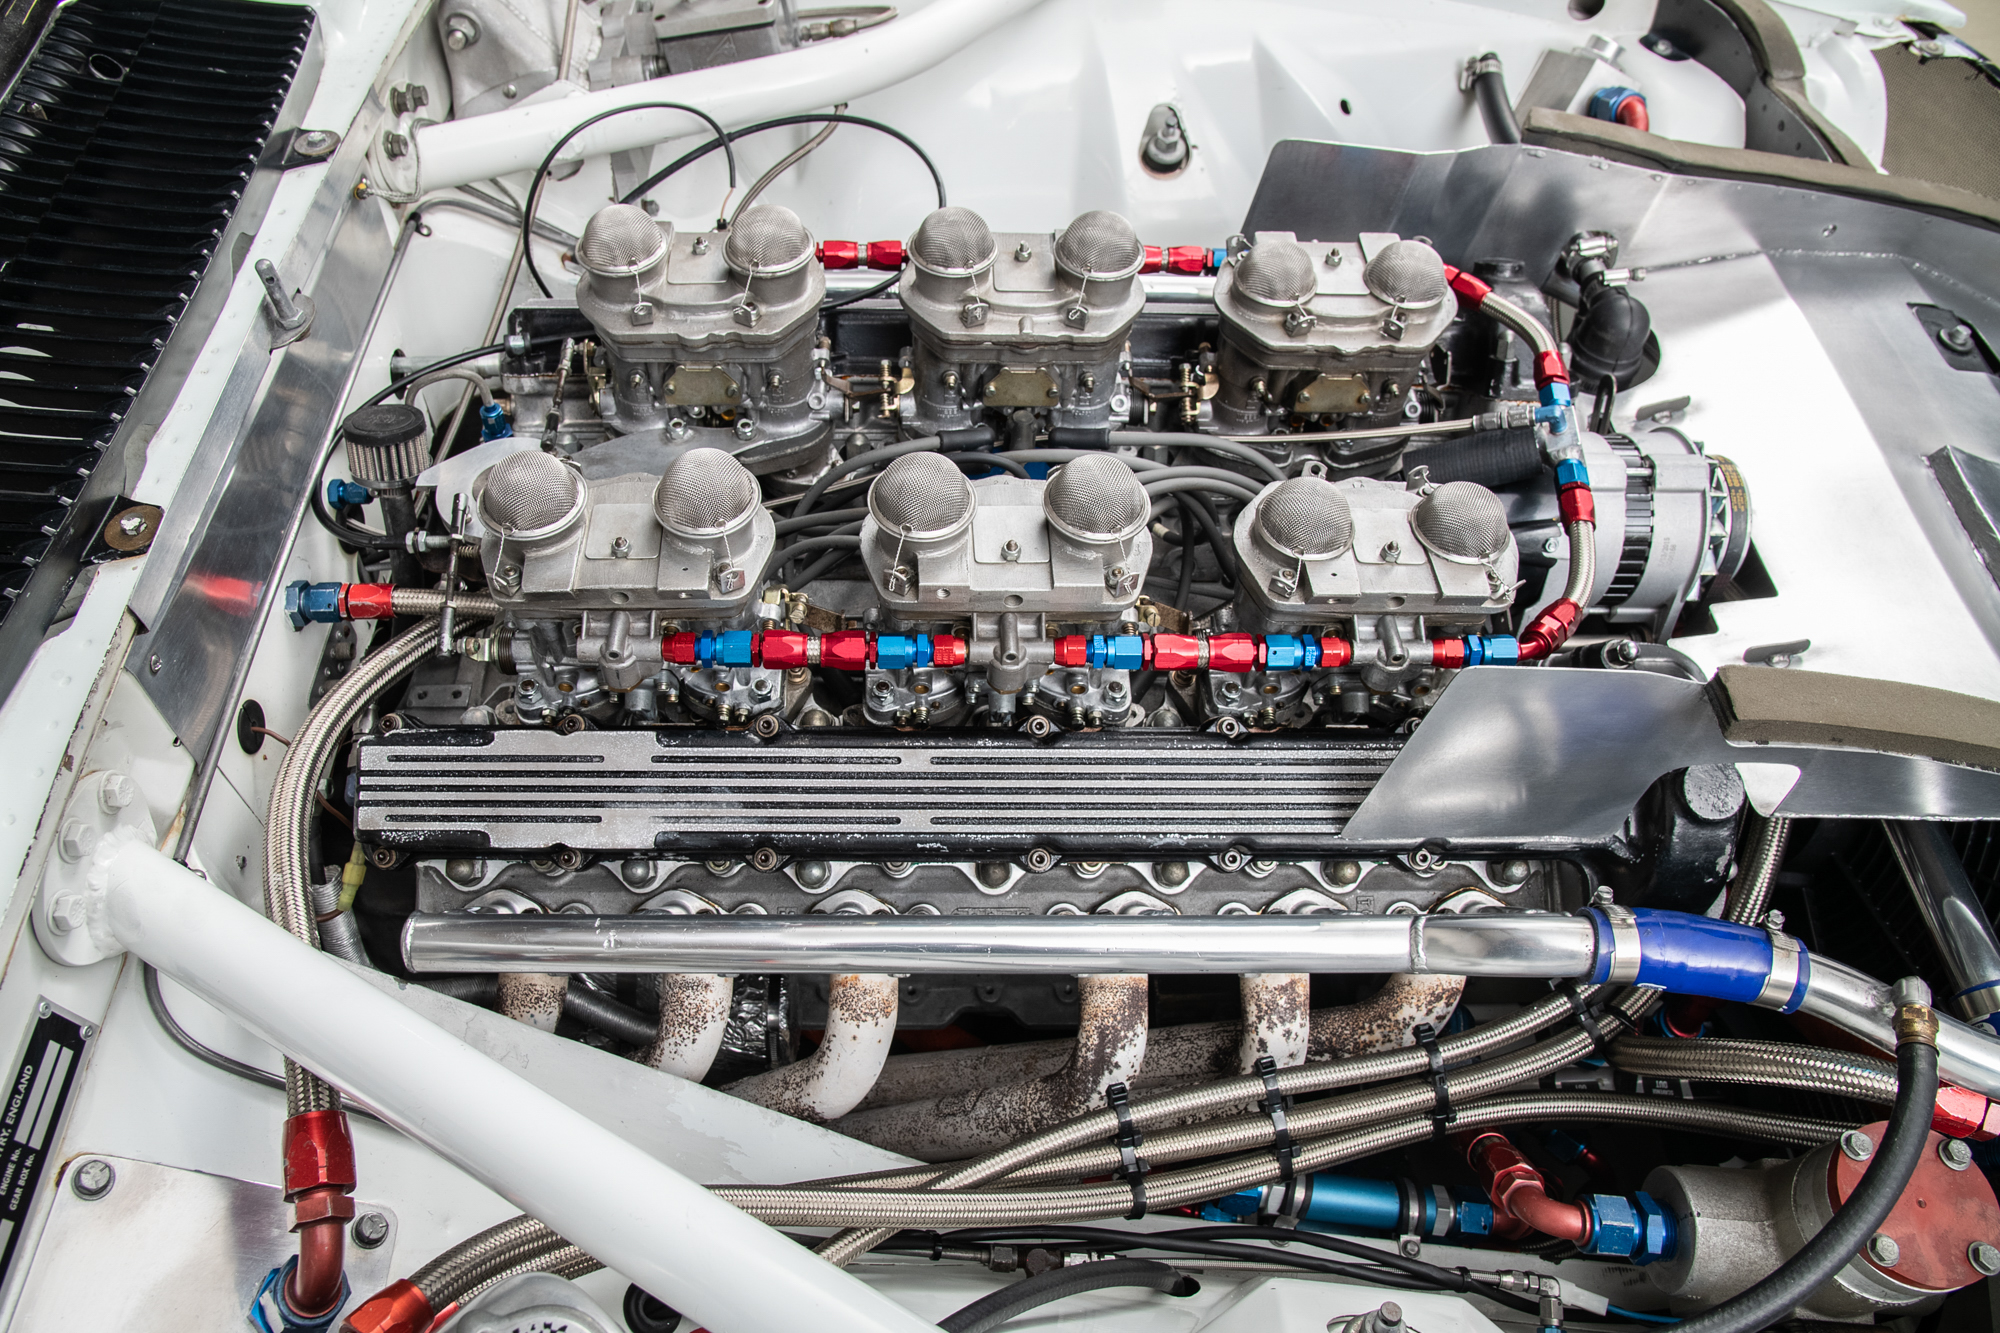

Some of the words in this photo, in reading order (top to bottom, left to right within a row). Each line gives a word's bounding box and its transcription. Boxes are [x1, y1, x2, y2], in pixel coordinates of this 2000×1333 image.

[5, 1065, 33, 1125] ENGLAND
[1655, 1080, 1668, 1089] OUT
[0, 1162, 17, 1196] ENGINE
[10, 1147, 22, 1162] No.
[24, 1153, 36, 1168] No.
[18, 1167, 31, 1187] BOX
[9, 1186, 24, 1211] GEAR
